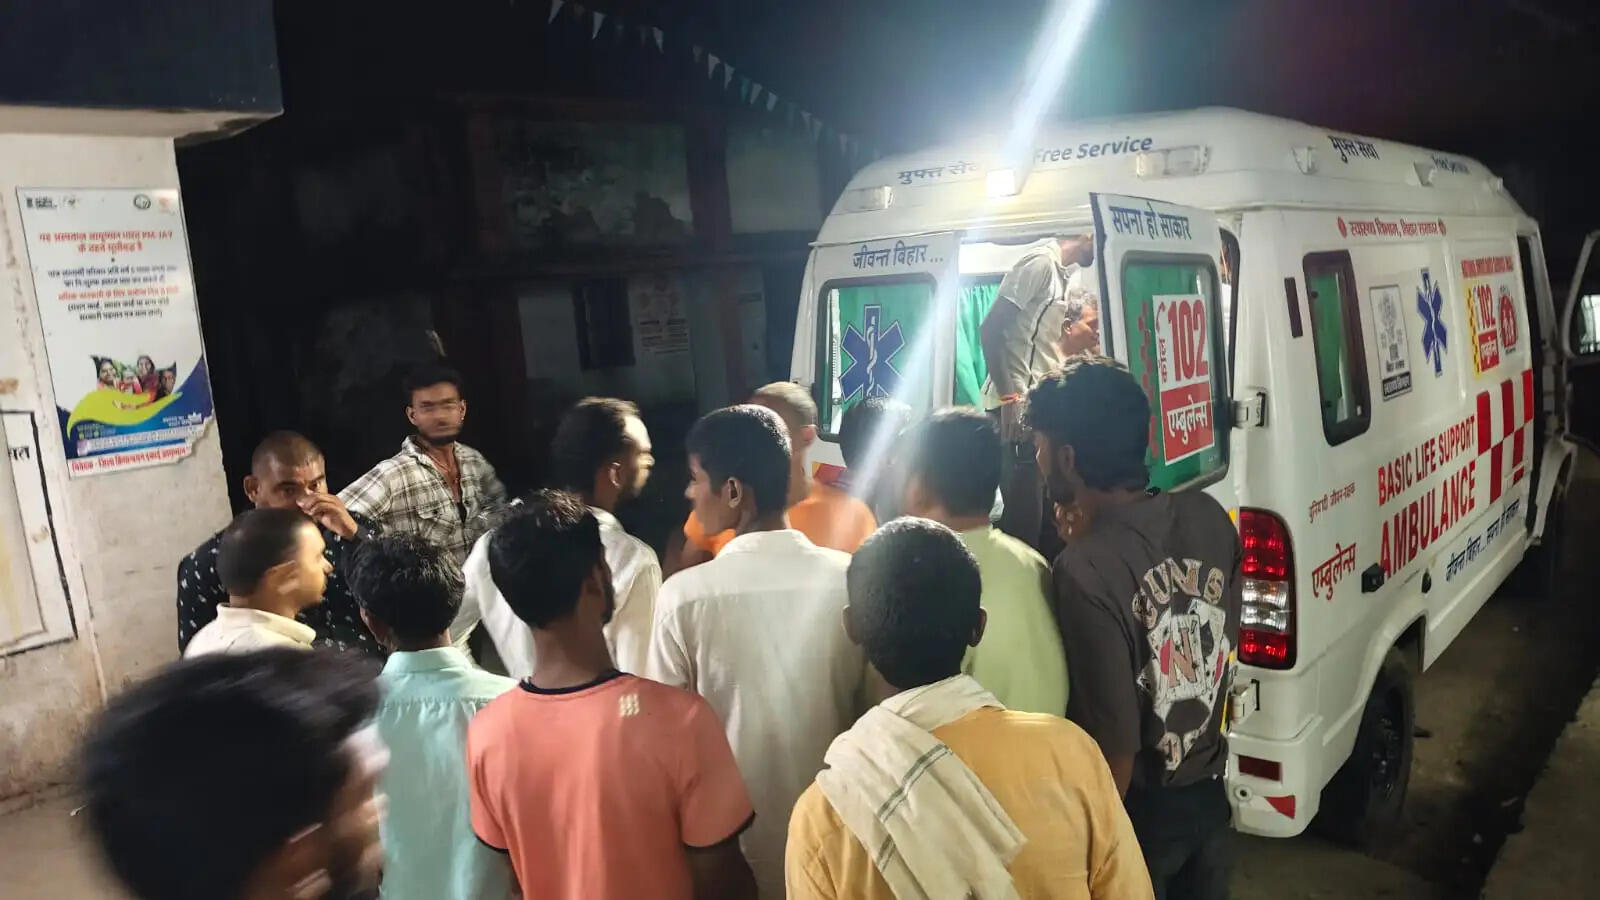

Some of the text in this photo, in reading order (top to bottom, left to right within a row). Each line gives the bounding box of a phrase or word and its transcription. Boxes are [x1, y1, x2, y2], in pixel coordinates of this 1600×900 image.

[1076, 136, 1153, 160] Service
[1108, 201, 1193, 241] सपना हो साकार
[853, 245, 891, 270] जीवन्त
[1168, 299, 1209, 382] 102
[1167, 395, 1209, 445] एम्बुलेन्स
[1378, 415, 1475, 507] BASIC LIFE SUPPORT
[1381, 459, 1476, 580] AMBULANCE
[1312, 542, 1356, 600] एम्बुलेन्स
